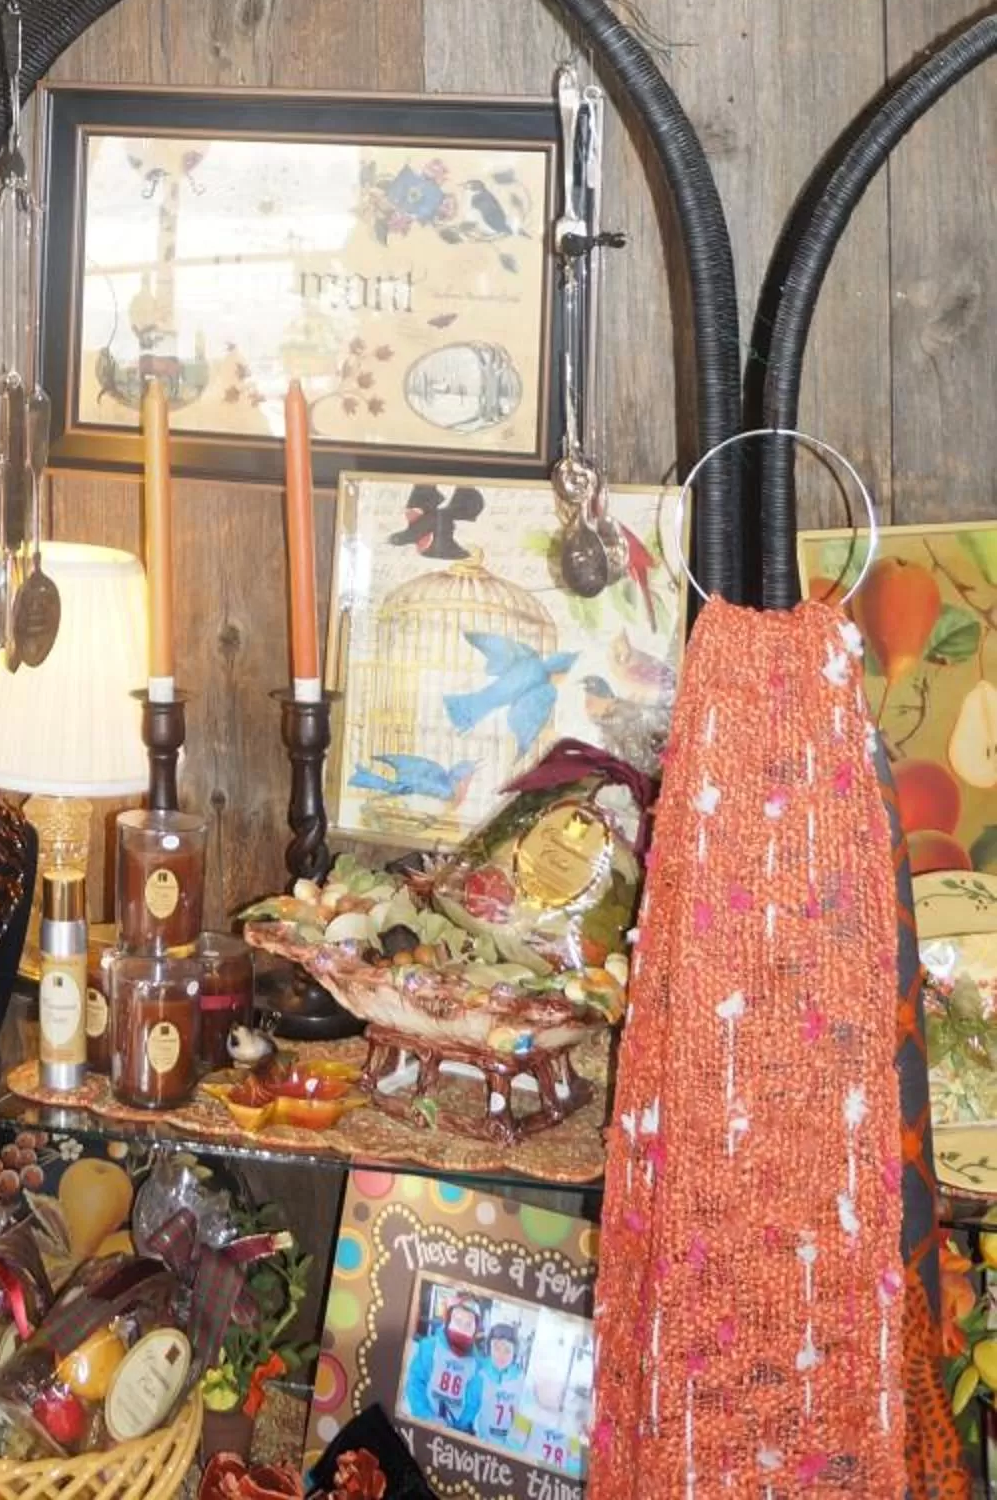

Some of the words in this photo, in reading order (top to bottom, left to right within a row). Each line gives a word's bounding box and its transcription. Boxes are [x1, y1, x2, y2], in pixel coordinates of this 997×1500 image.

[394, 1231, 459, 1270] These
[464, 1246, 502, 1277] are
[508, 1257, 527, 1288] a
[535, 1262, 587, 1304] few
[426, 1434, 514, 1487] favorite
